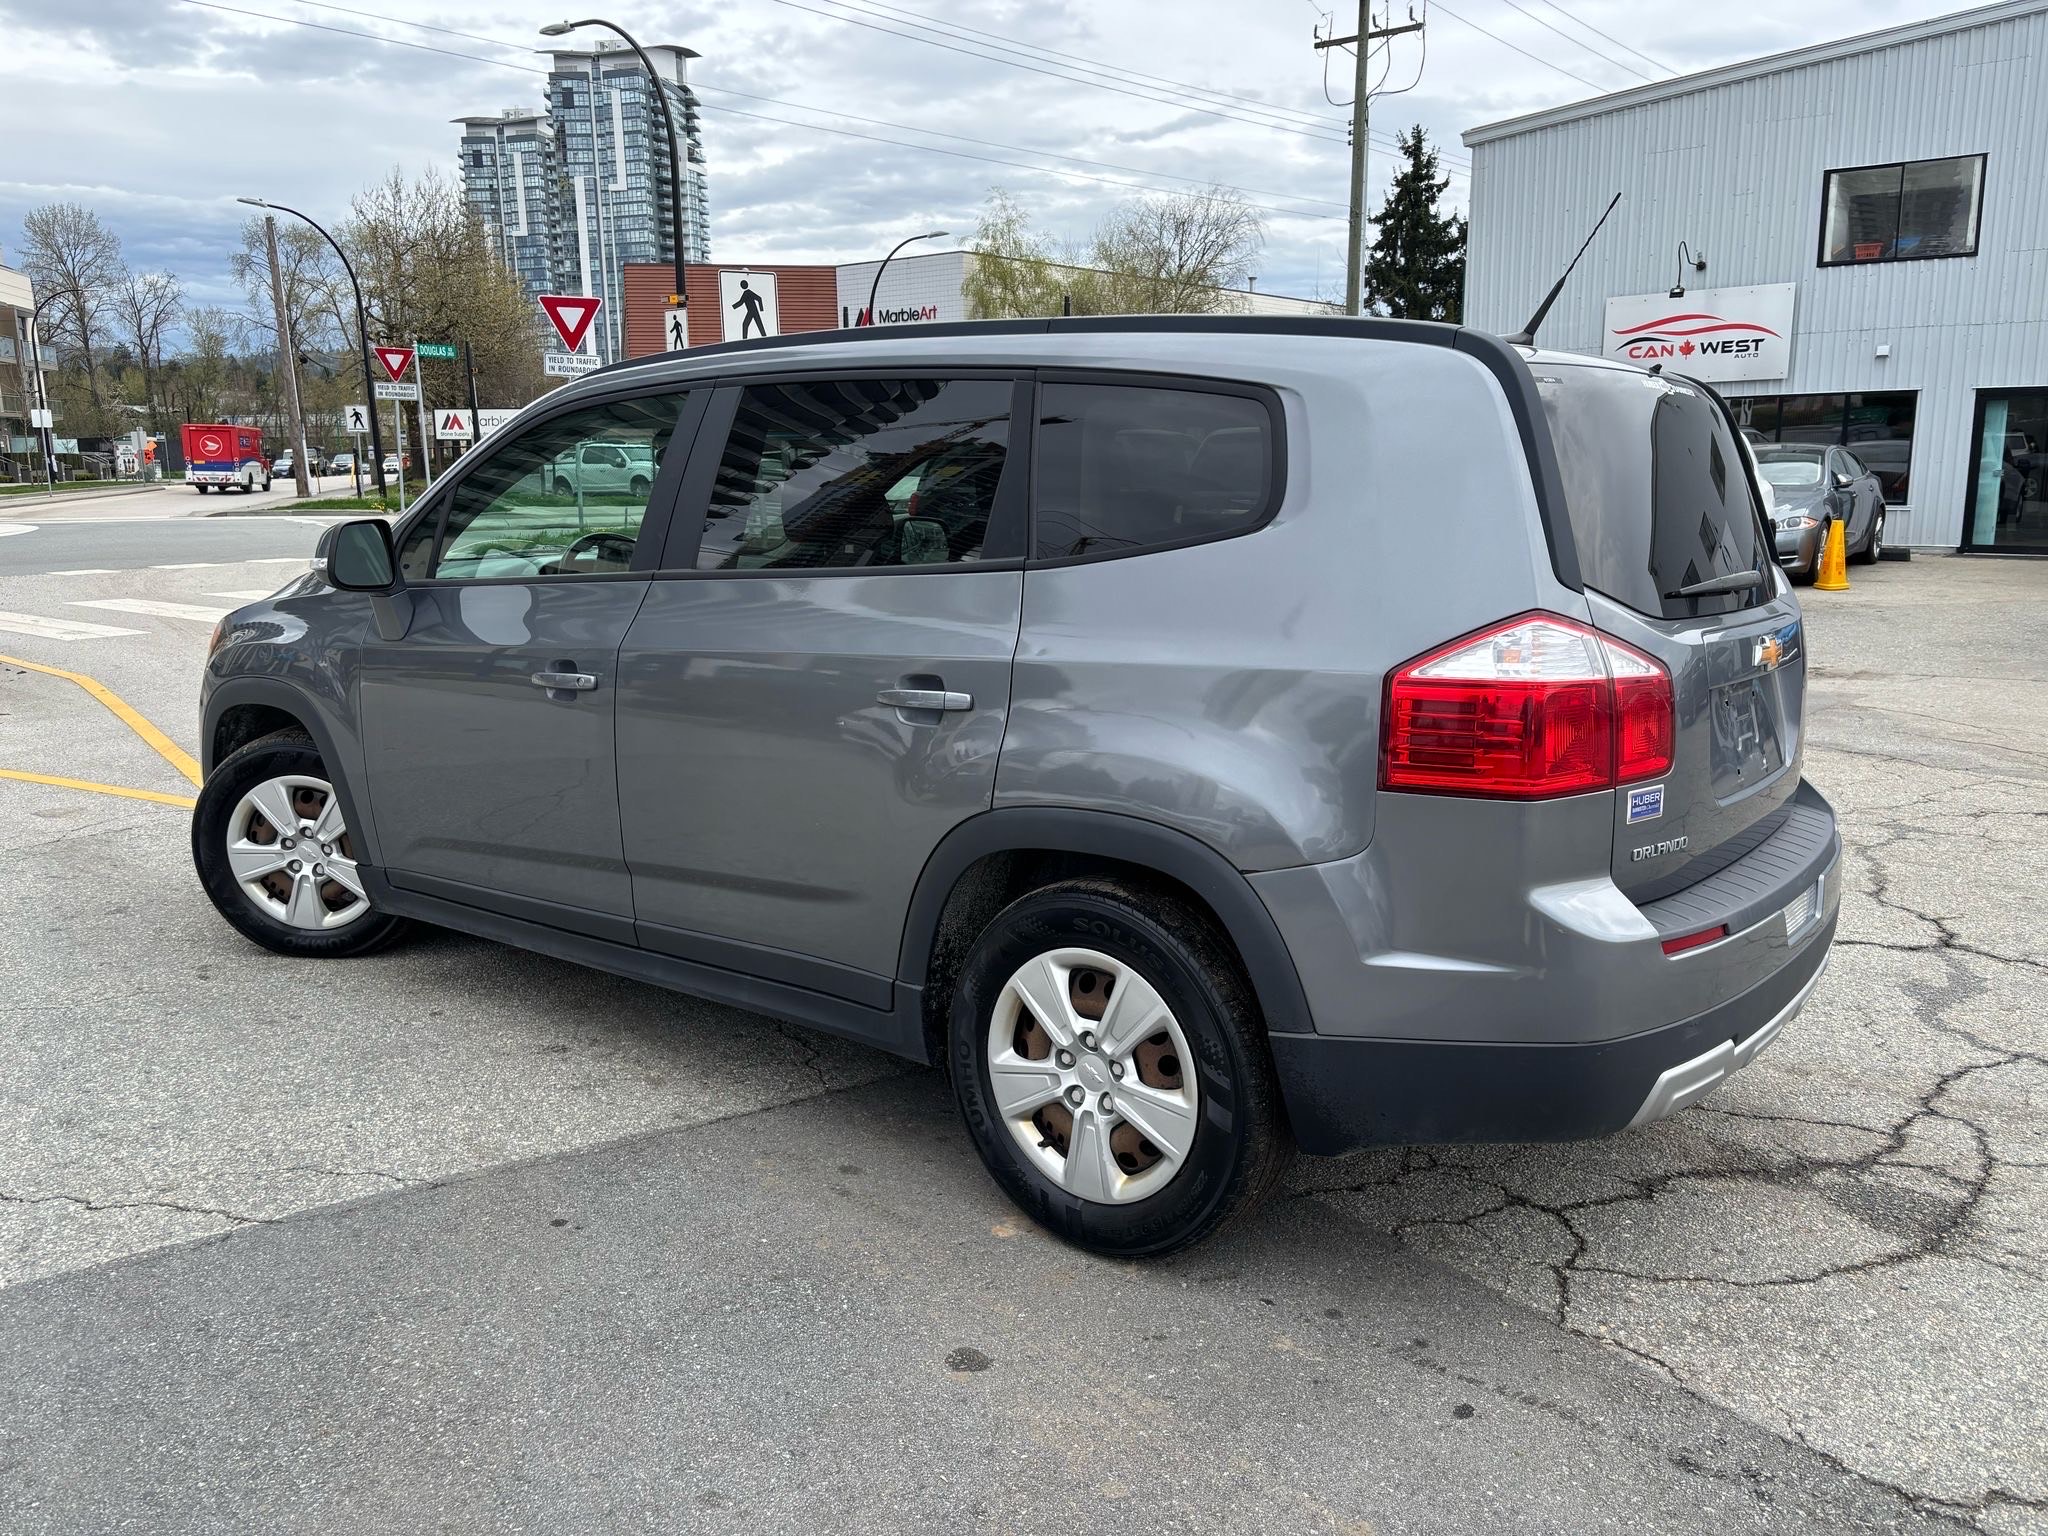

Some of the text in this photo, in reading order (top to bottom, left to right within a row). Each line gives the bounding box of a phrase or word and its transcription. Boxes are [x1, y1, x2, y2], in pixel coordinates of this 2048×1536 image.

[879, 305, 937, 324] MarbleArt
[419, 345, 447, 357] DOUGLAS
[1628, 338, 1765, 359] CAN WEST
[548, 356, 564, 364] YIELD
[576, 357, 598, 366] TRAFFIC
[1632, 792, 1661, 806] HUBER
[1632, 836, 1689, 862] ORLANDO
[1072, 917, 1163, 970] SOLUS
